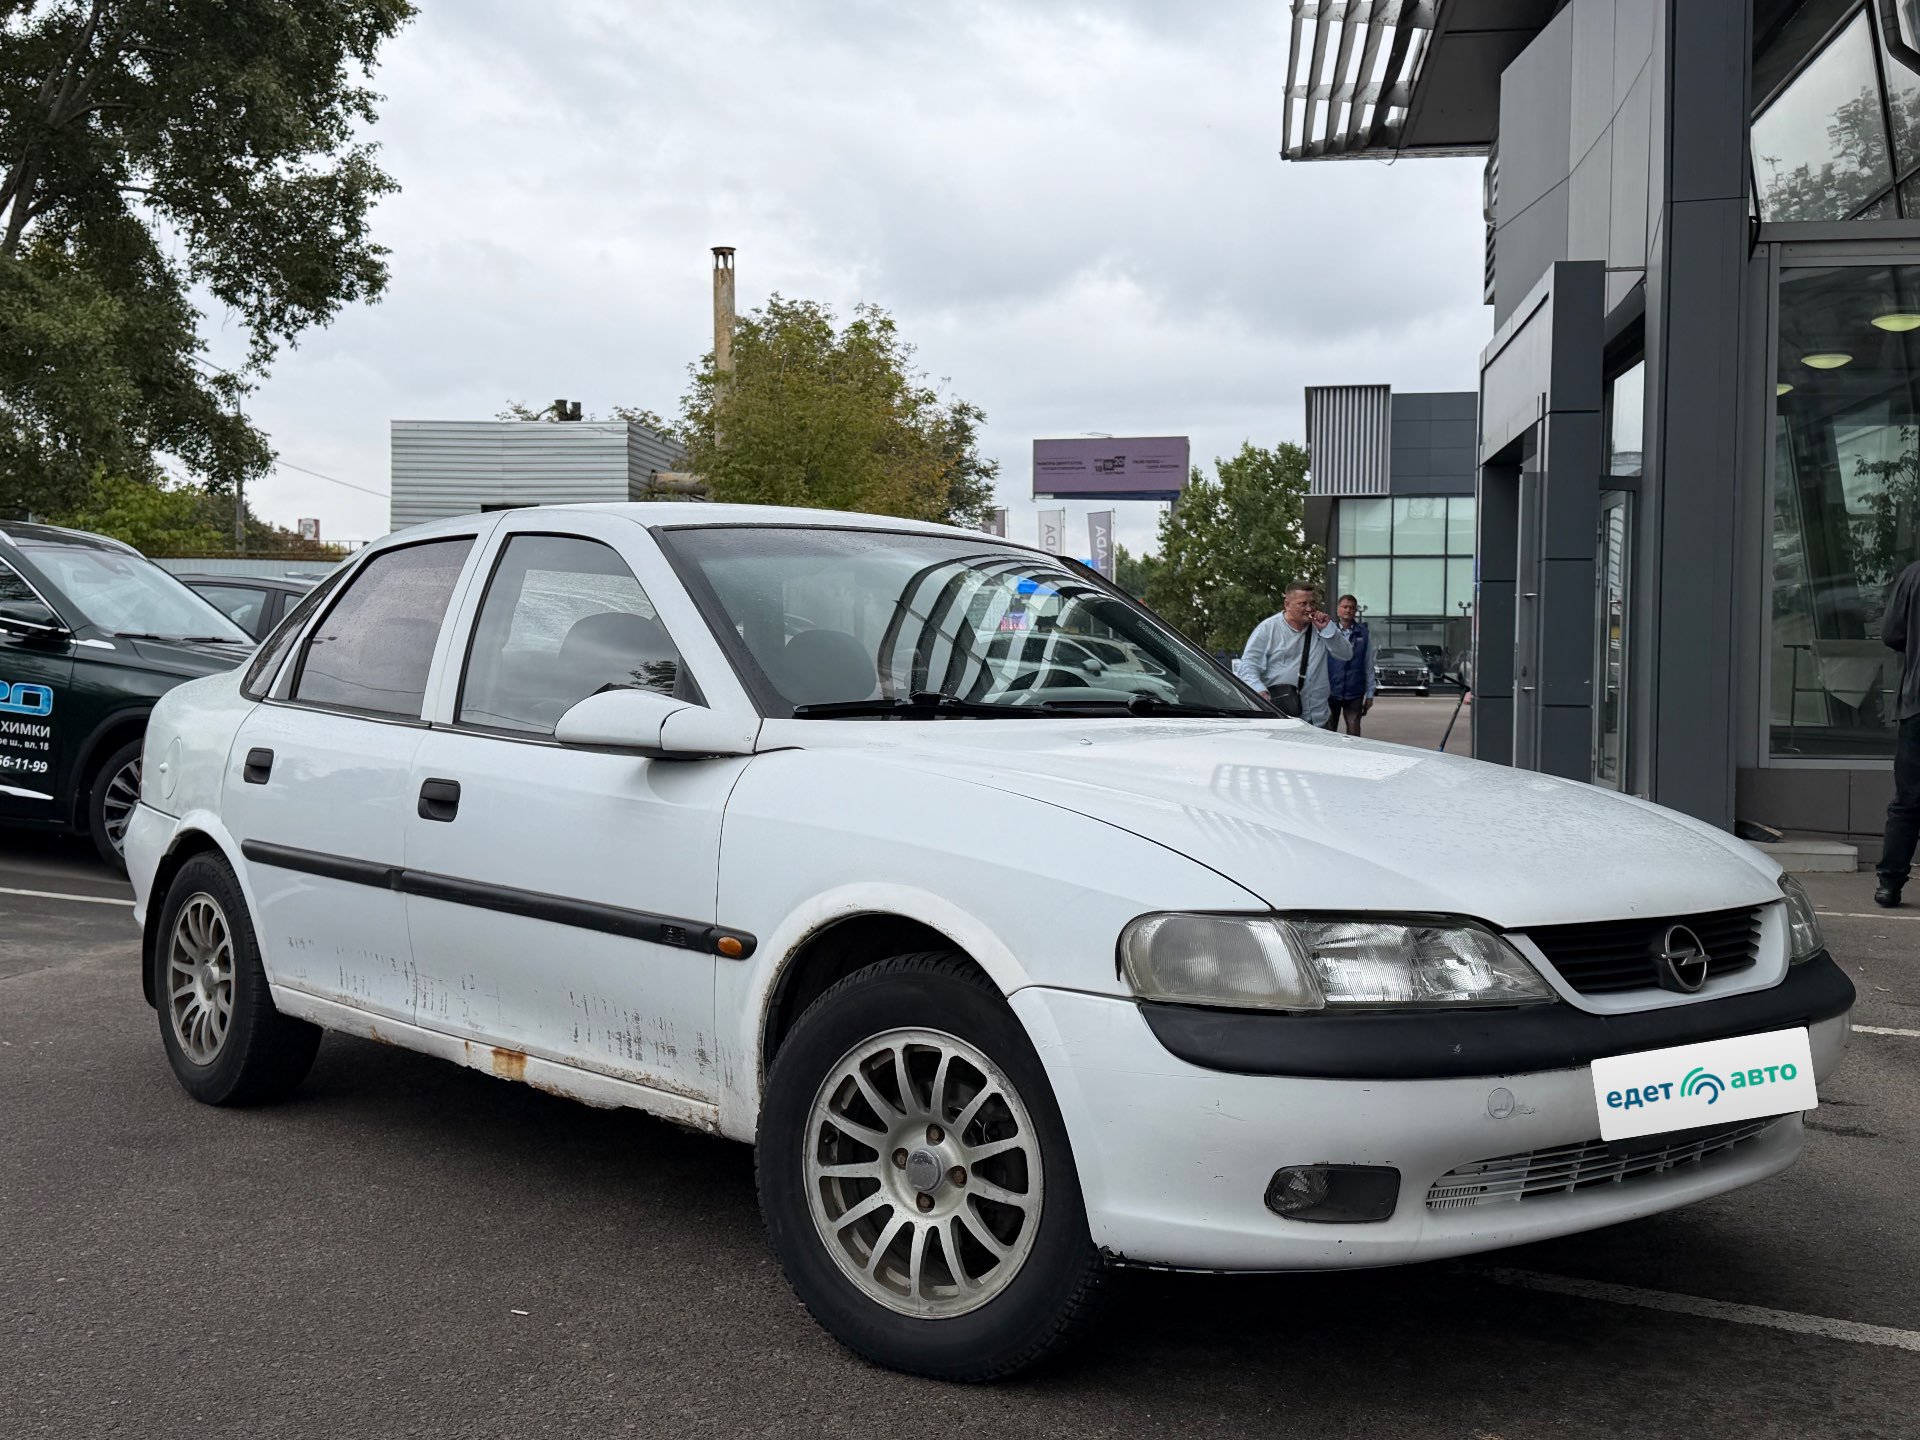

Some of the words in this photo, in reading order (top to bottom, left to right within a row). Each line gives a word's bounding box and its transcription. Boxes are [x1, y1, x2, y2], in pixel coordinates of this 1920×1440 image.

[1, 720, 51, 738] ХИМКИ
[24, 741, 38, 750] вл.
[39, 741, 50, 751] 18
